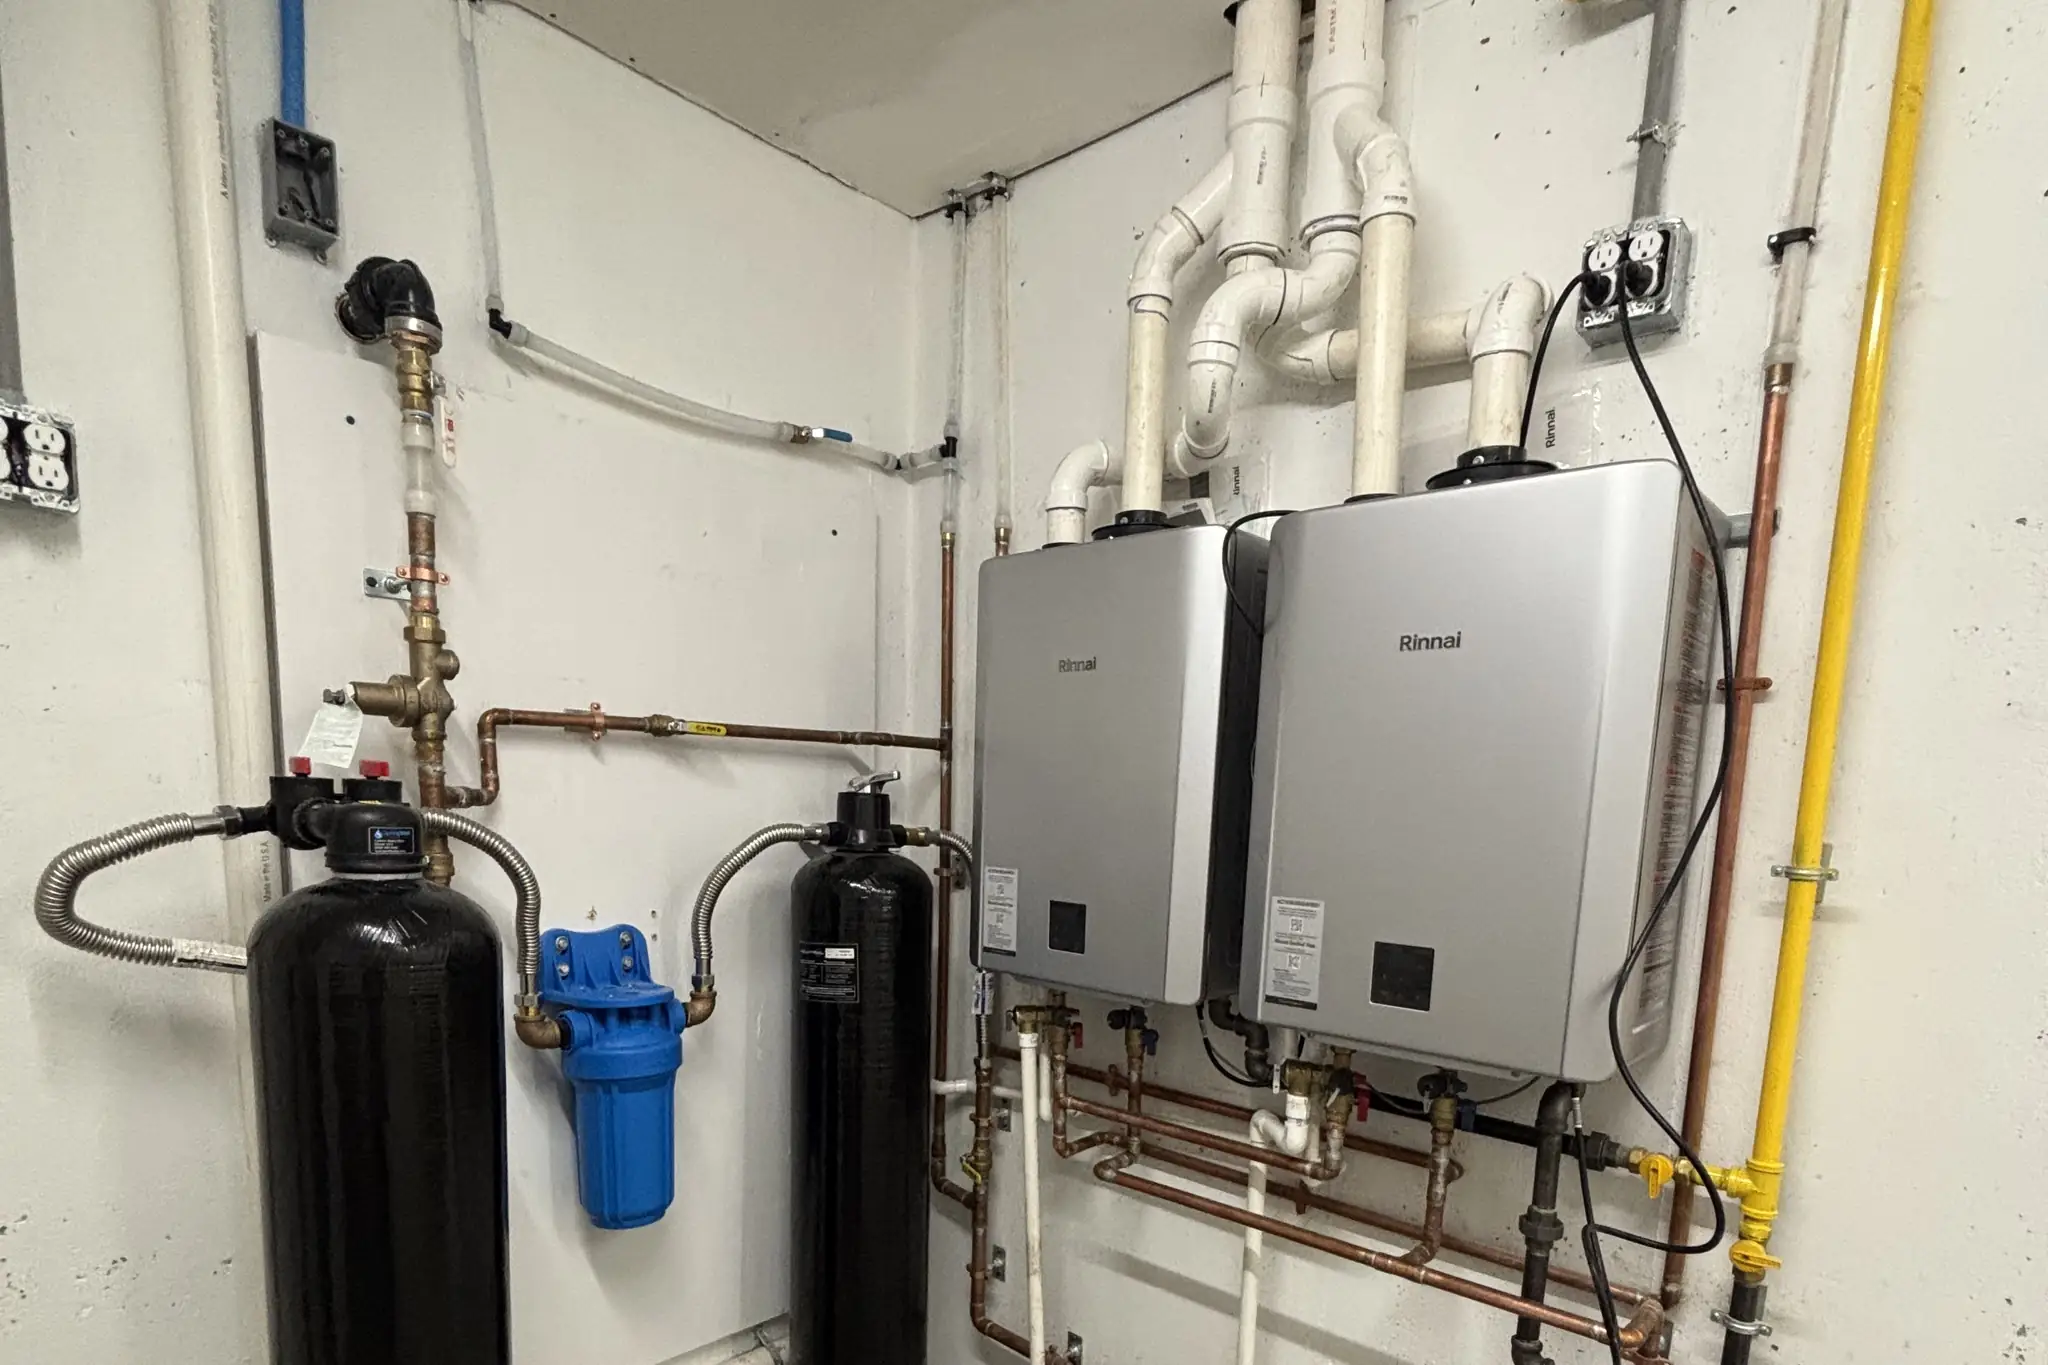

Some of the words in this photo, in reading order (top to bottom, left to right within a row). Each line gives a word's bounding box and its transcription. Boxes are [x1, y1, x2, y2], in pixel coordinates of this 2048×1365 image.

[1544, 408, 1556, 449] Rinnai
[1399, 630, 1462, 652] Rinnai
[1058, 655, 1097, 673] Rinnai
